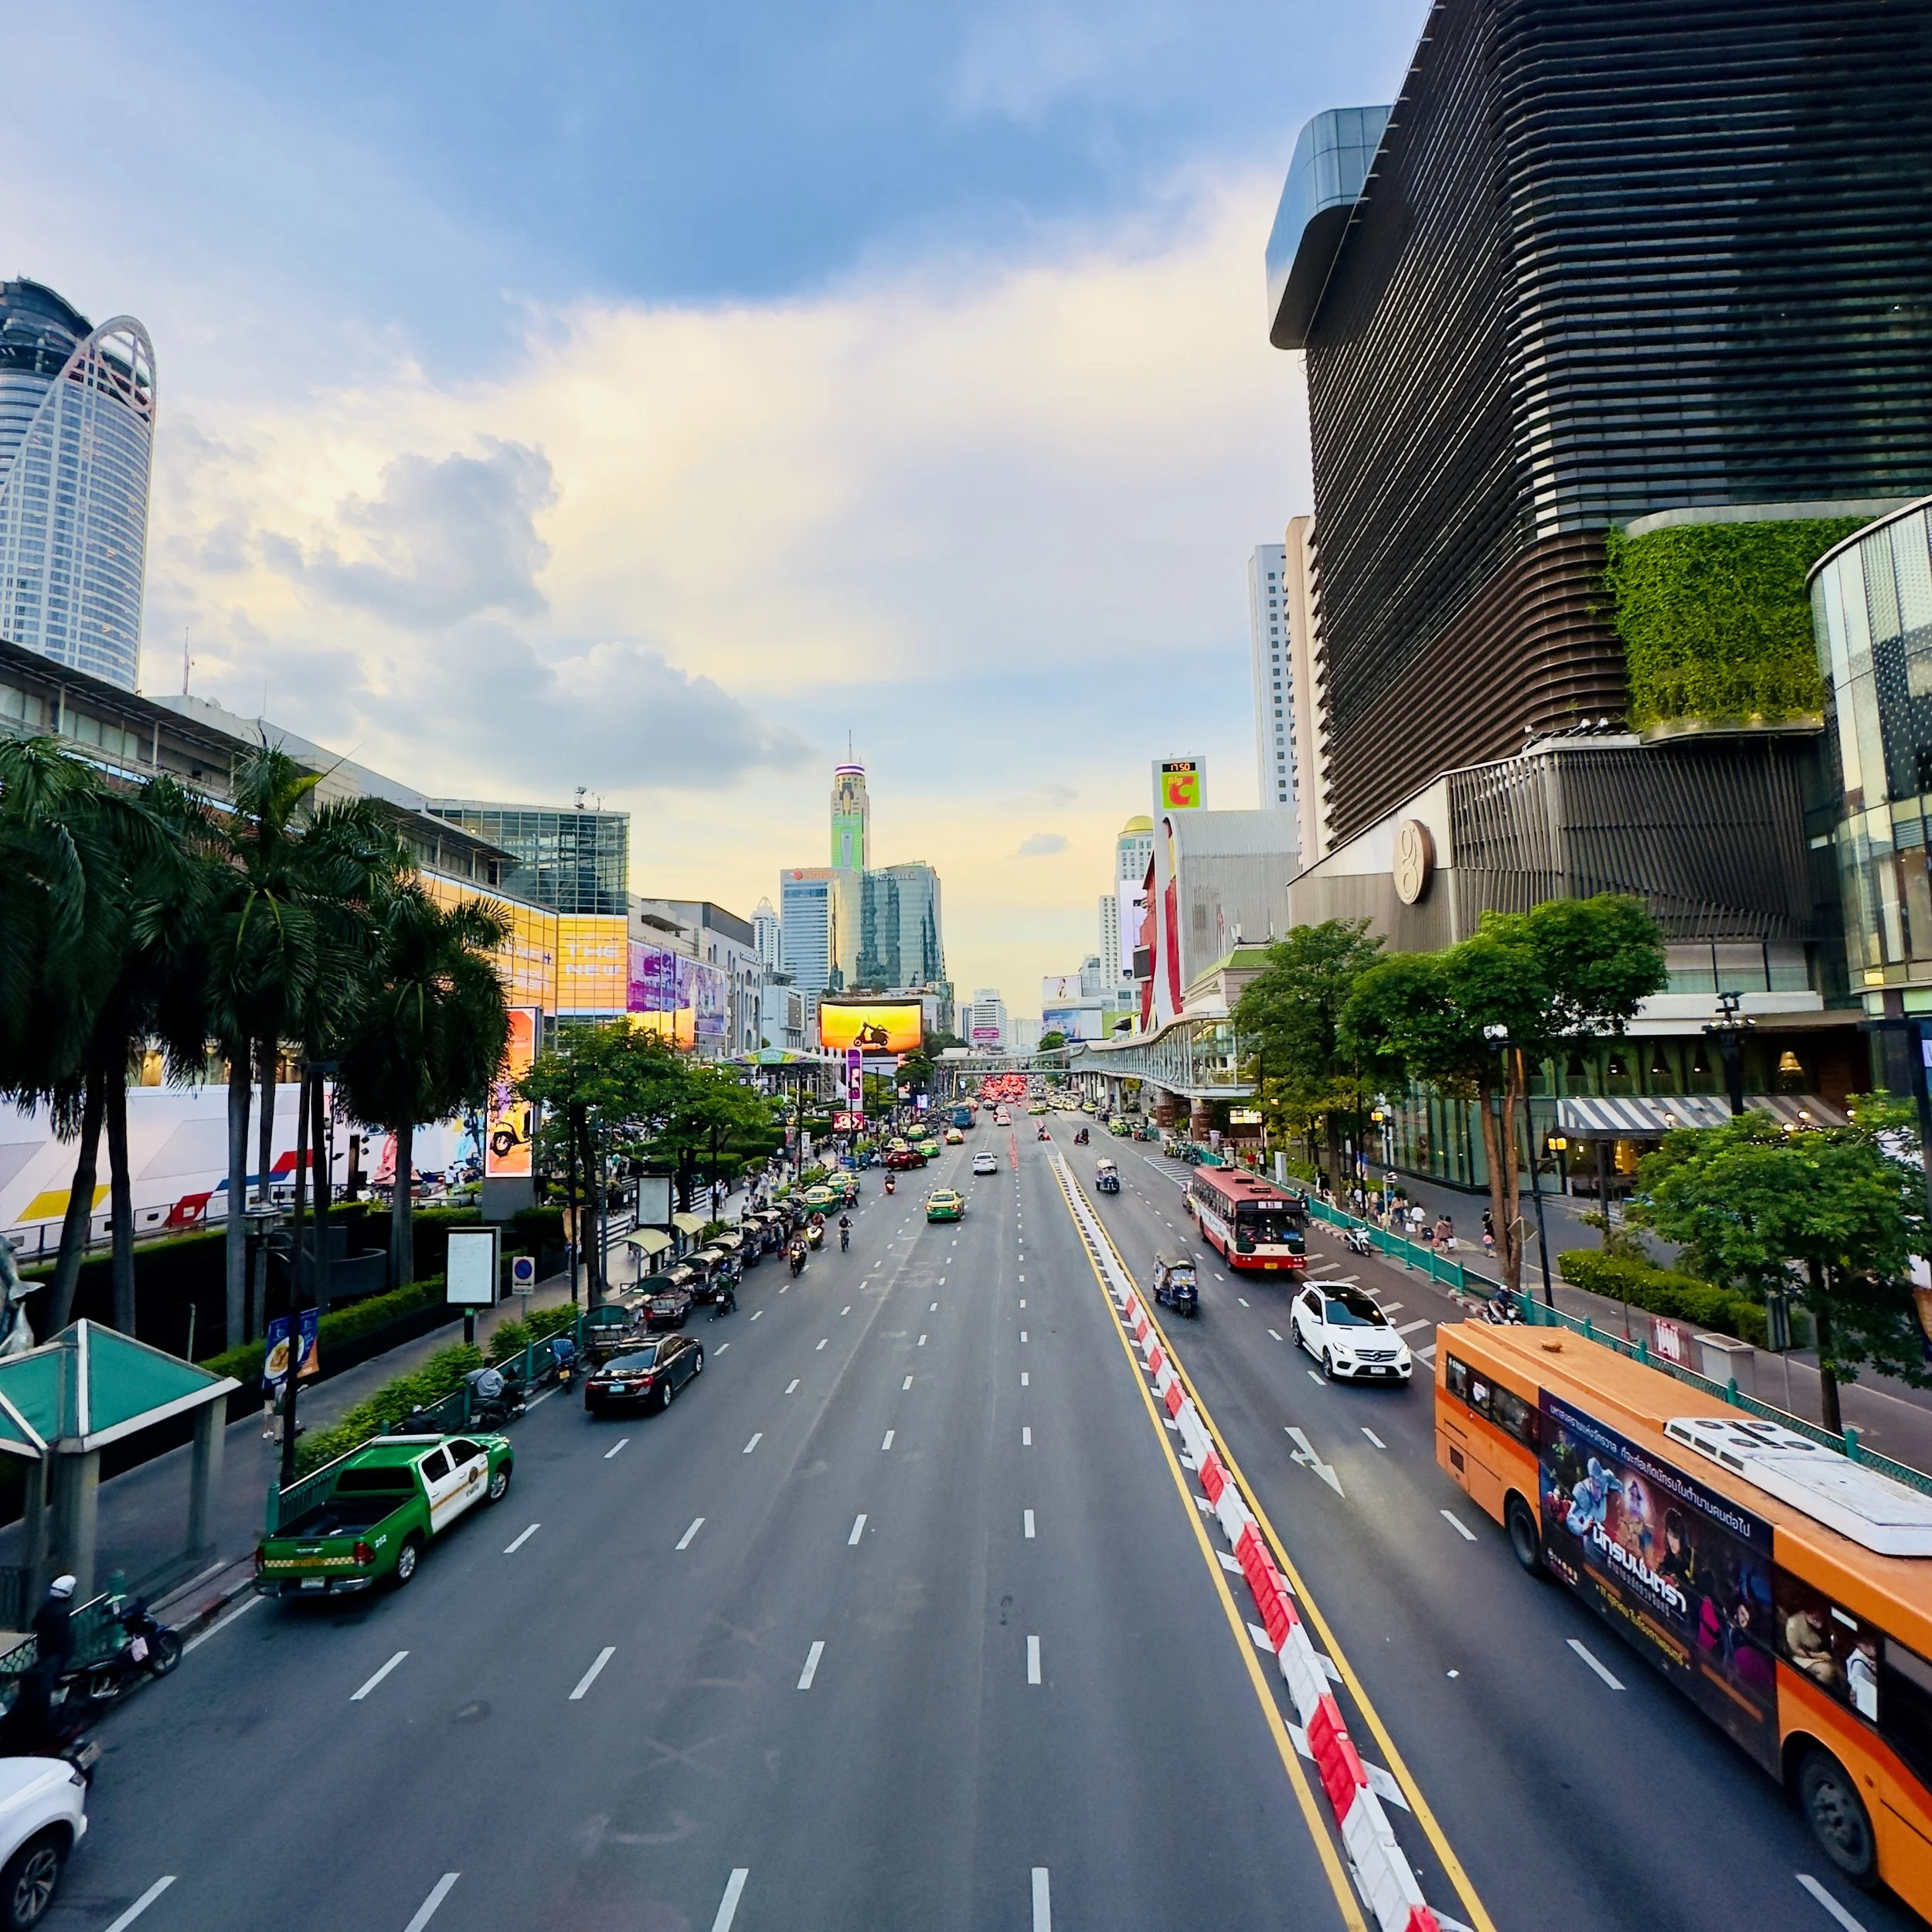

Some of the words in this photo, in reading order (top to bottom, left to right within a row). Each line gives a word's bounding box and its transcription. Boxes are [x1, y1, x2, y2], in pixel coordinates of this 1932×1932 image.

[1167, 777, 1183, 785] Big
[1169, 776, 1194, 805] C
[876, 871, 915, 881] NOVOTEL
[565, 944, 619, 957] THE
[566, 964, 620, 975] NEW
